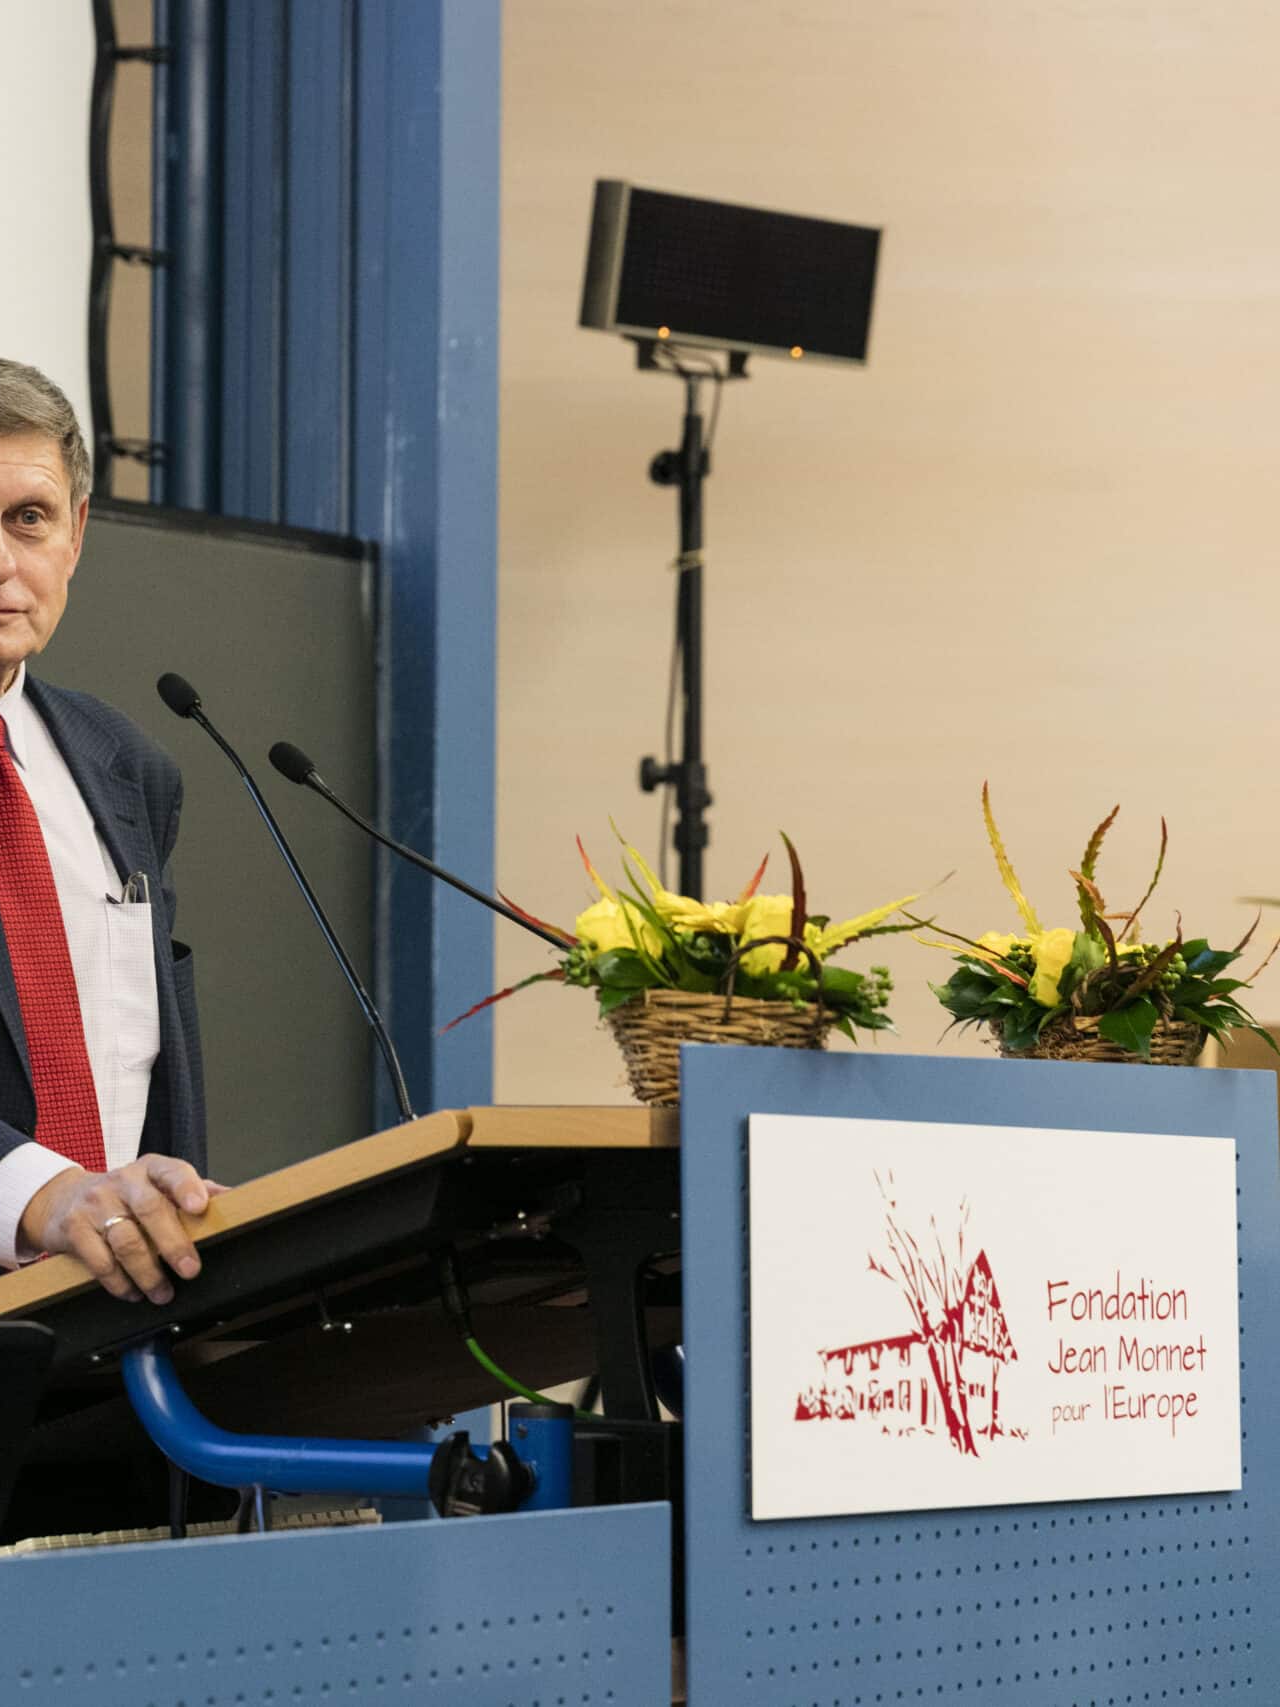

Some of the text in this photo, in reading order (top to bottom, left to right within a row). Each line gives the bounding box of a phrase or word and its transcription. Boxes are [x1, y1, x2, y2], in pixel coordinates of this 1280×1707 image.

[1046, 1270, 1188, 1322] Fondation
[1047, 1334, 1208, 1375] Jean Monnet
[1051, 1403, 1092, 1435] pour
